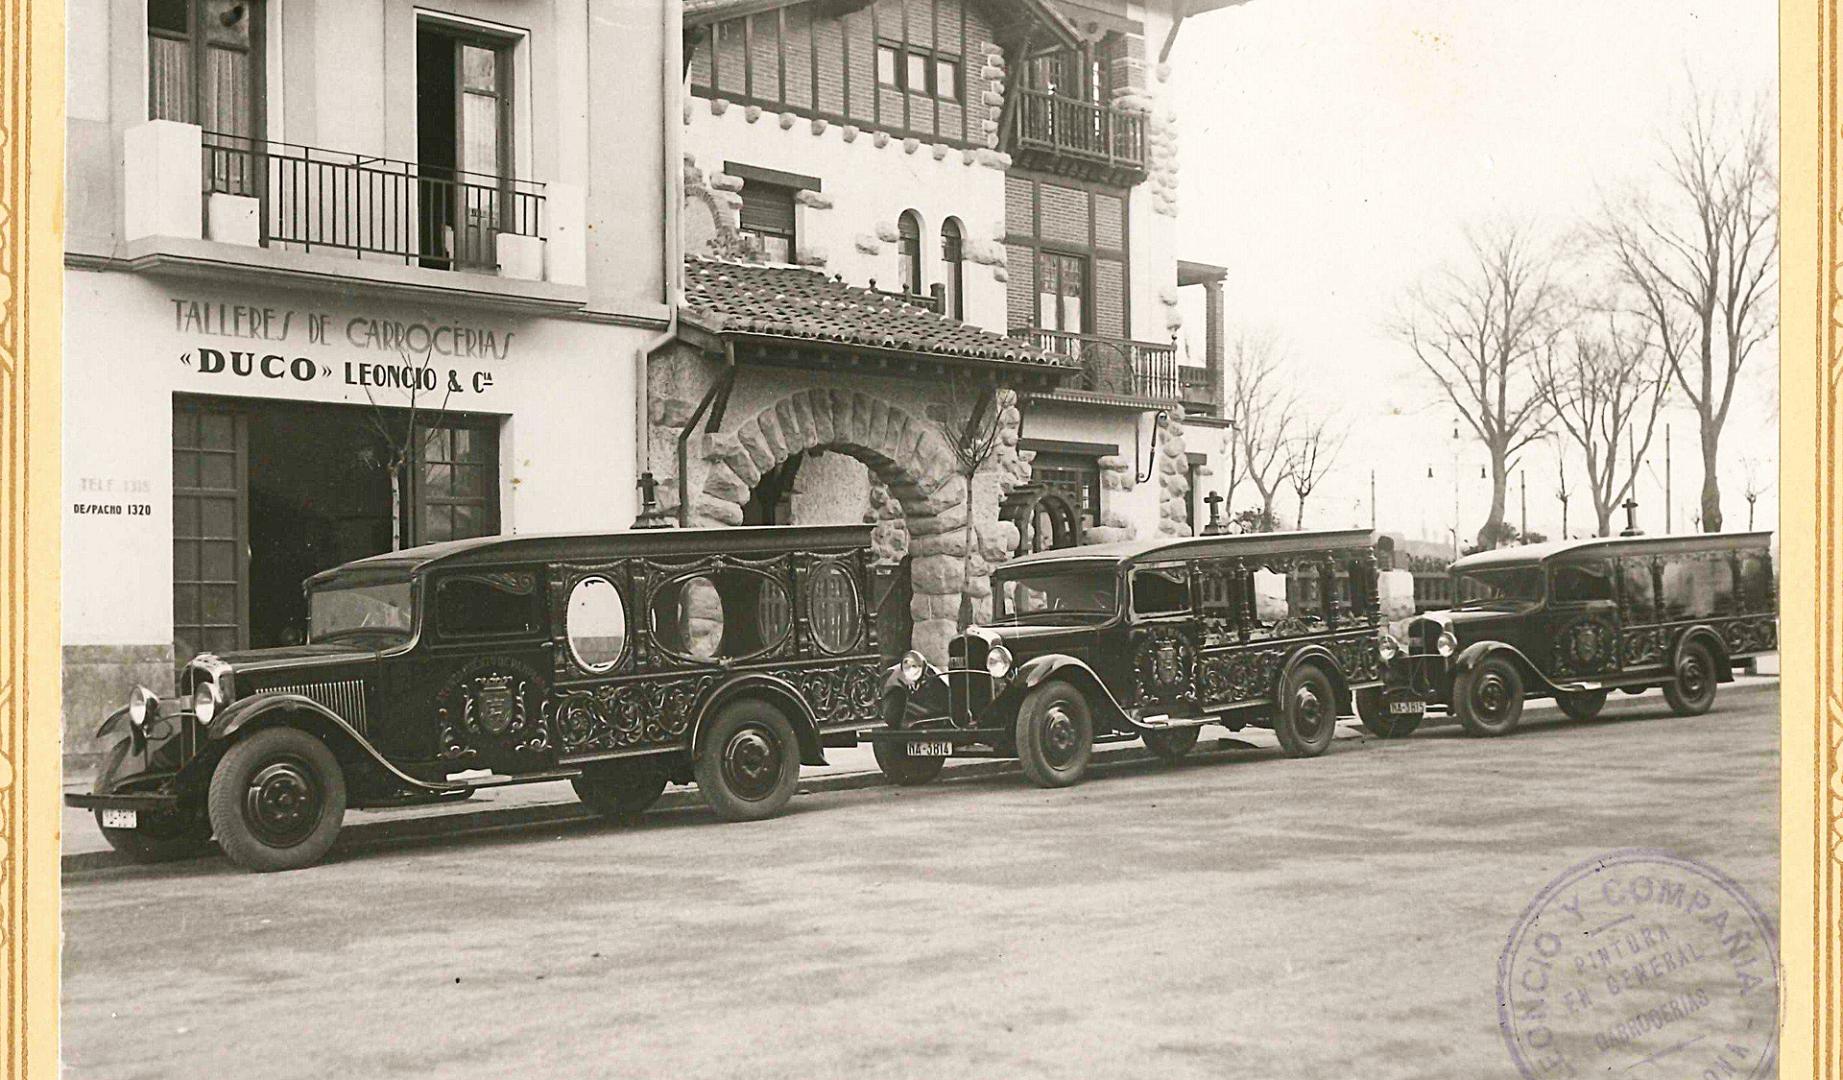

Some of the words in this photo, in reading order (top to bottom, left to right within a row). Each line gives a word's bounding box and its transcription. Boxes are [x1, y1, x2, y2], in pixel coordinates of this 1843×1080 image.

[171, 298, 295, 341] TALLERES
[308, 311, 332, 346] DE
[344, 361, 437, 392] LEONCIO
[447, 369, 464, 393] &
[127, 504, 152, 516] 1320
